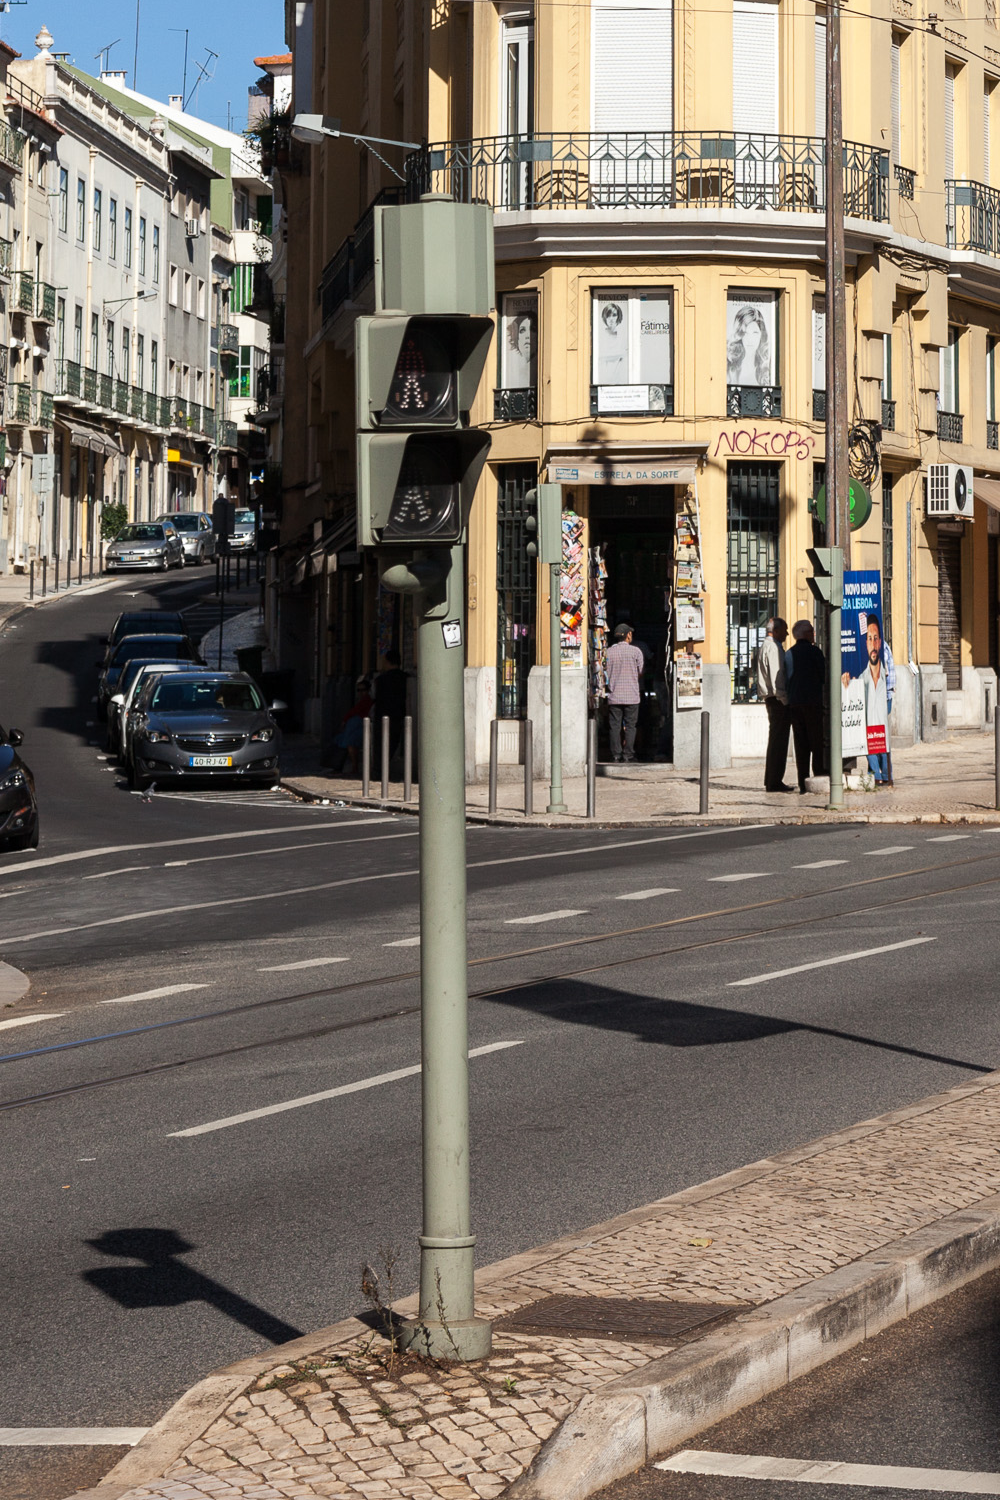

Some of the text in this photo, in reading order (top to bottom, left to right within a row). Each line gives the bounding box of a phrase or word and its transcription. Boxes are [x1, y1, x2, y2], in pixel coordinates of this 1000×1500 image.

[640, 320, 669, 331] Fátima
[594, 470, 679, 479] ESTRELA DA SORTE
[844, 582, 878, 596] NOVO RUMO
[852, 598, 874, 610] LISBOA
